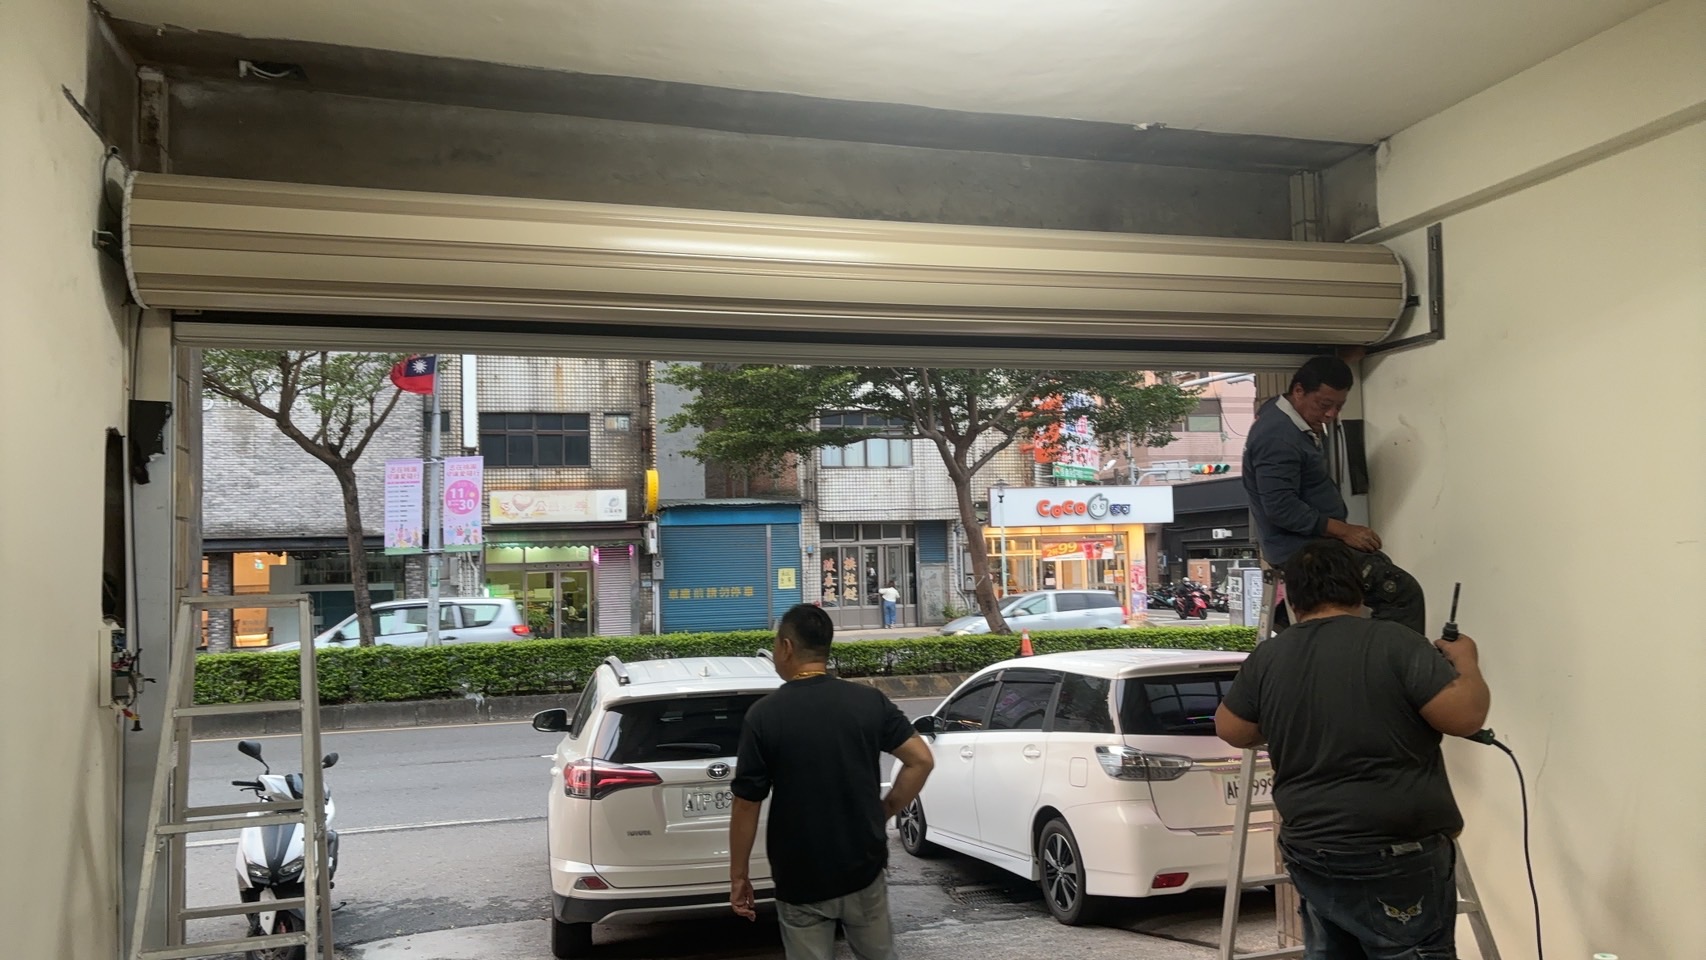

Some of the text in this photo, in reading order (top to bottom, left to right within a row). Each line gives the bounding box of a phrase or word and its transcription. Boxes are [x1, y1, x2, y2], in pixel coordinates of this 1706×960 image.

[450, 488, 464, 498] 11
[458, 499, 475, 510] 30
[668, 586, 753, 599] 車庫前請勿停車
